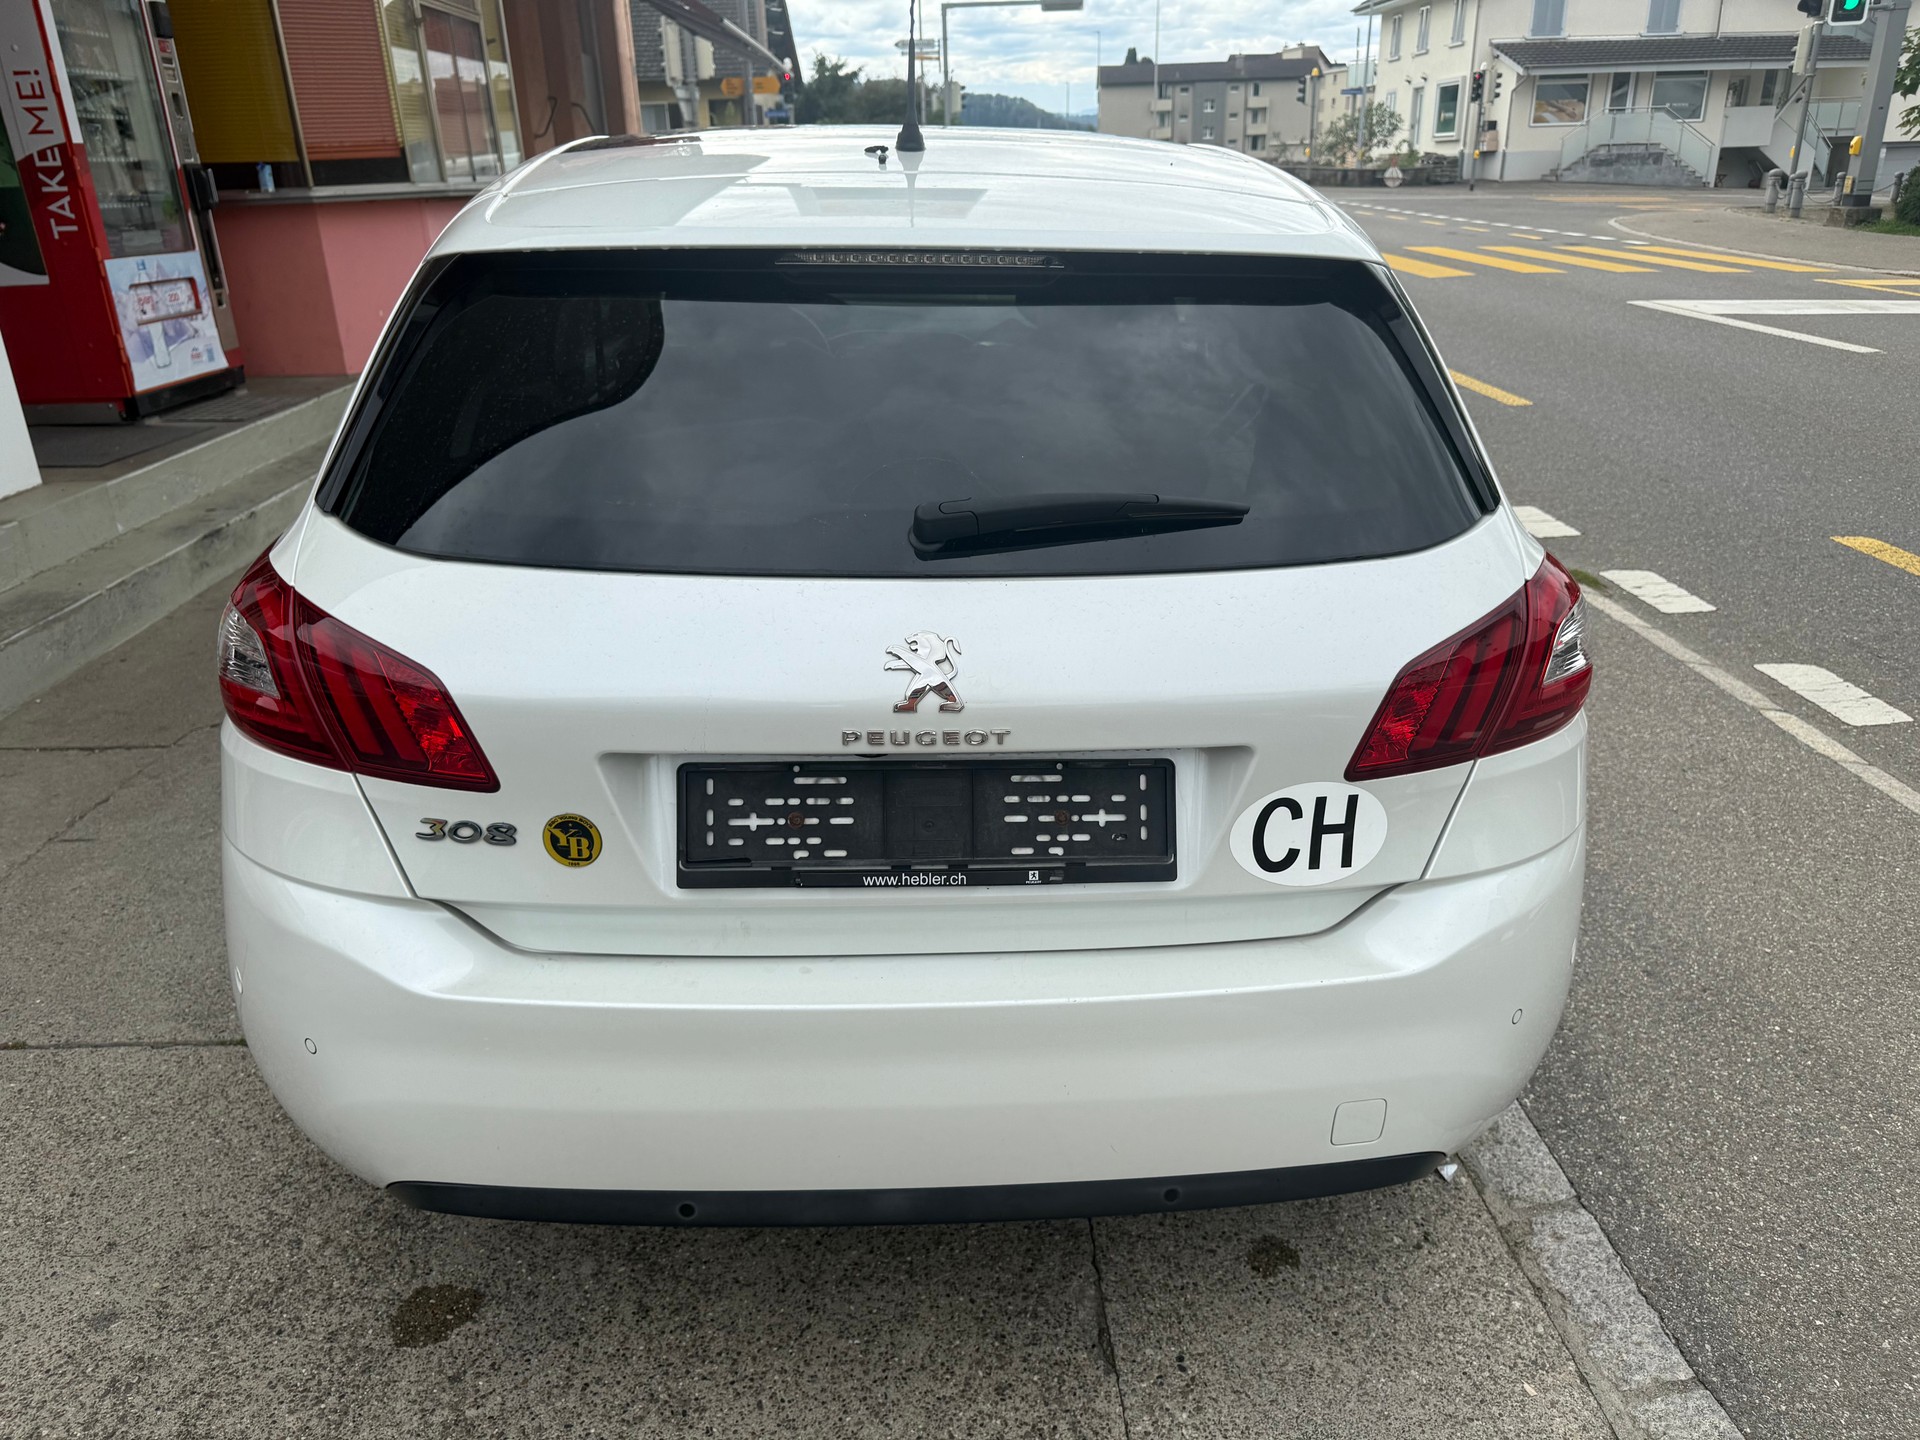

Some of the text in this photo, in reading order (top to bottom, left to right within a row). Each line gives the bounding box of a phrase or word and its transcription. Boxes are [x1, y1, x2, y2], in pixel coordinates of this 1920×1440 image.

[13, 69, 79, 240] TAKE ME!
[842, 729, 1011, 746] PEUGEOT
[415, 817, 517, 846] 308
[547, 828, 591, 859] YB
[1252, 794, 1359, 873] CH
[862, 872, 967, 885] www.hebler.ch
